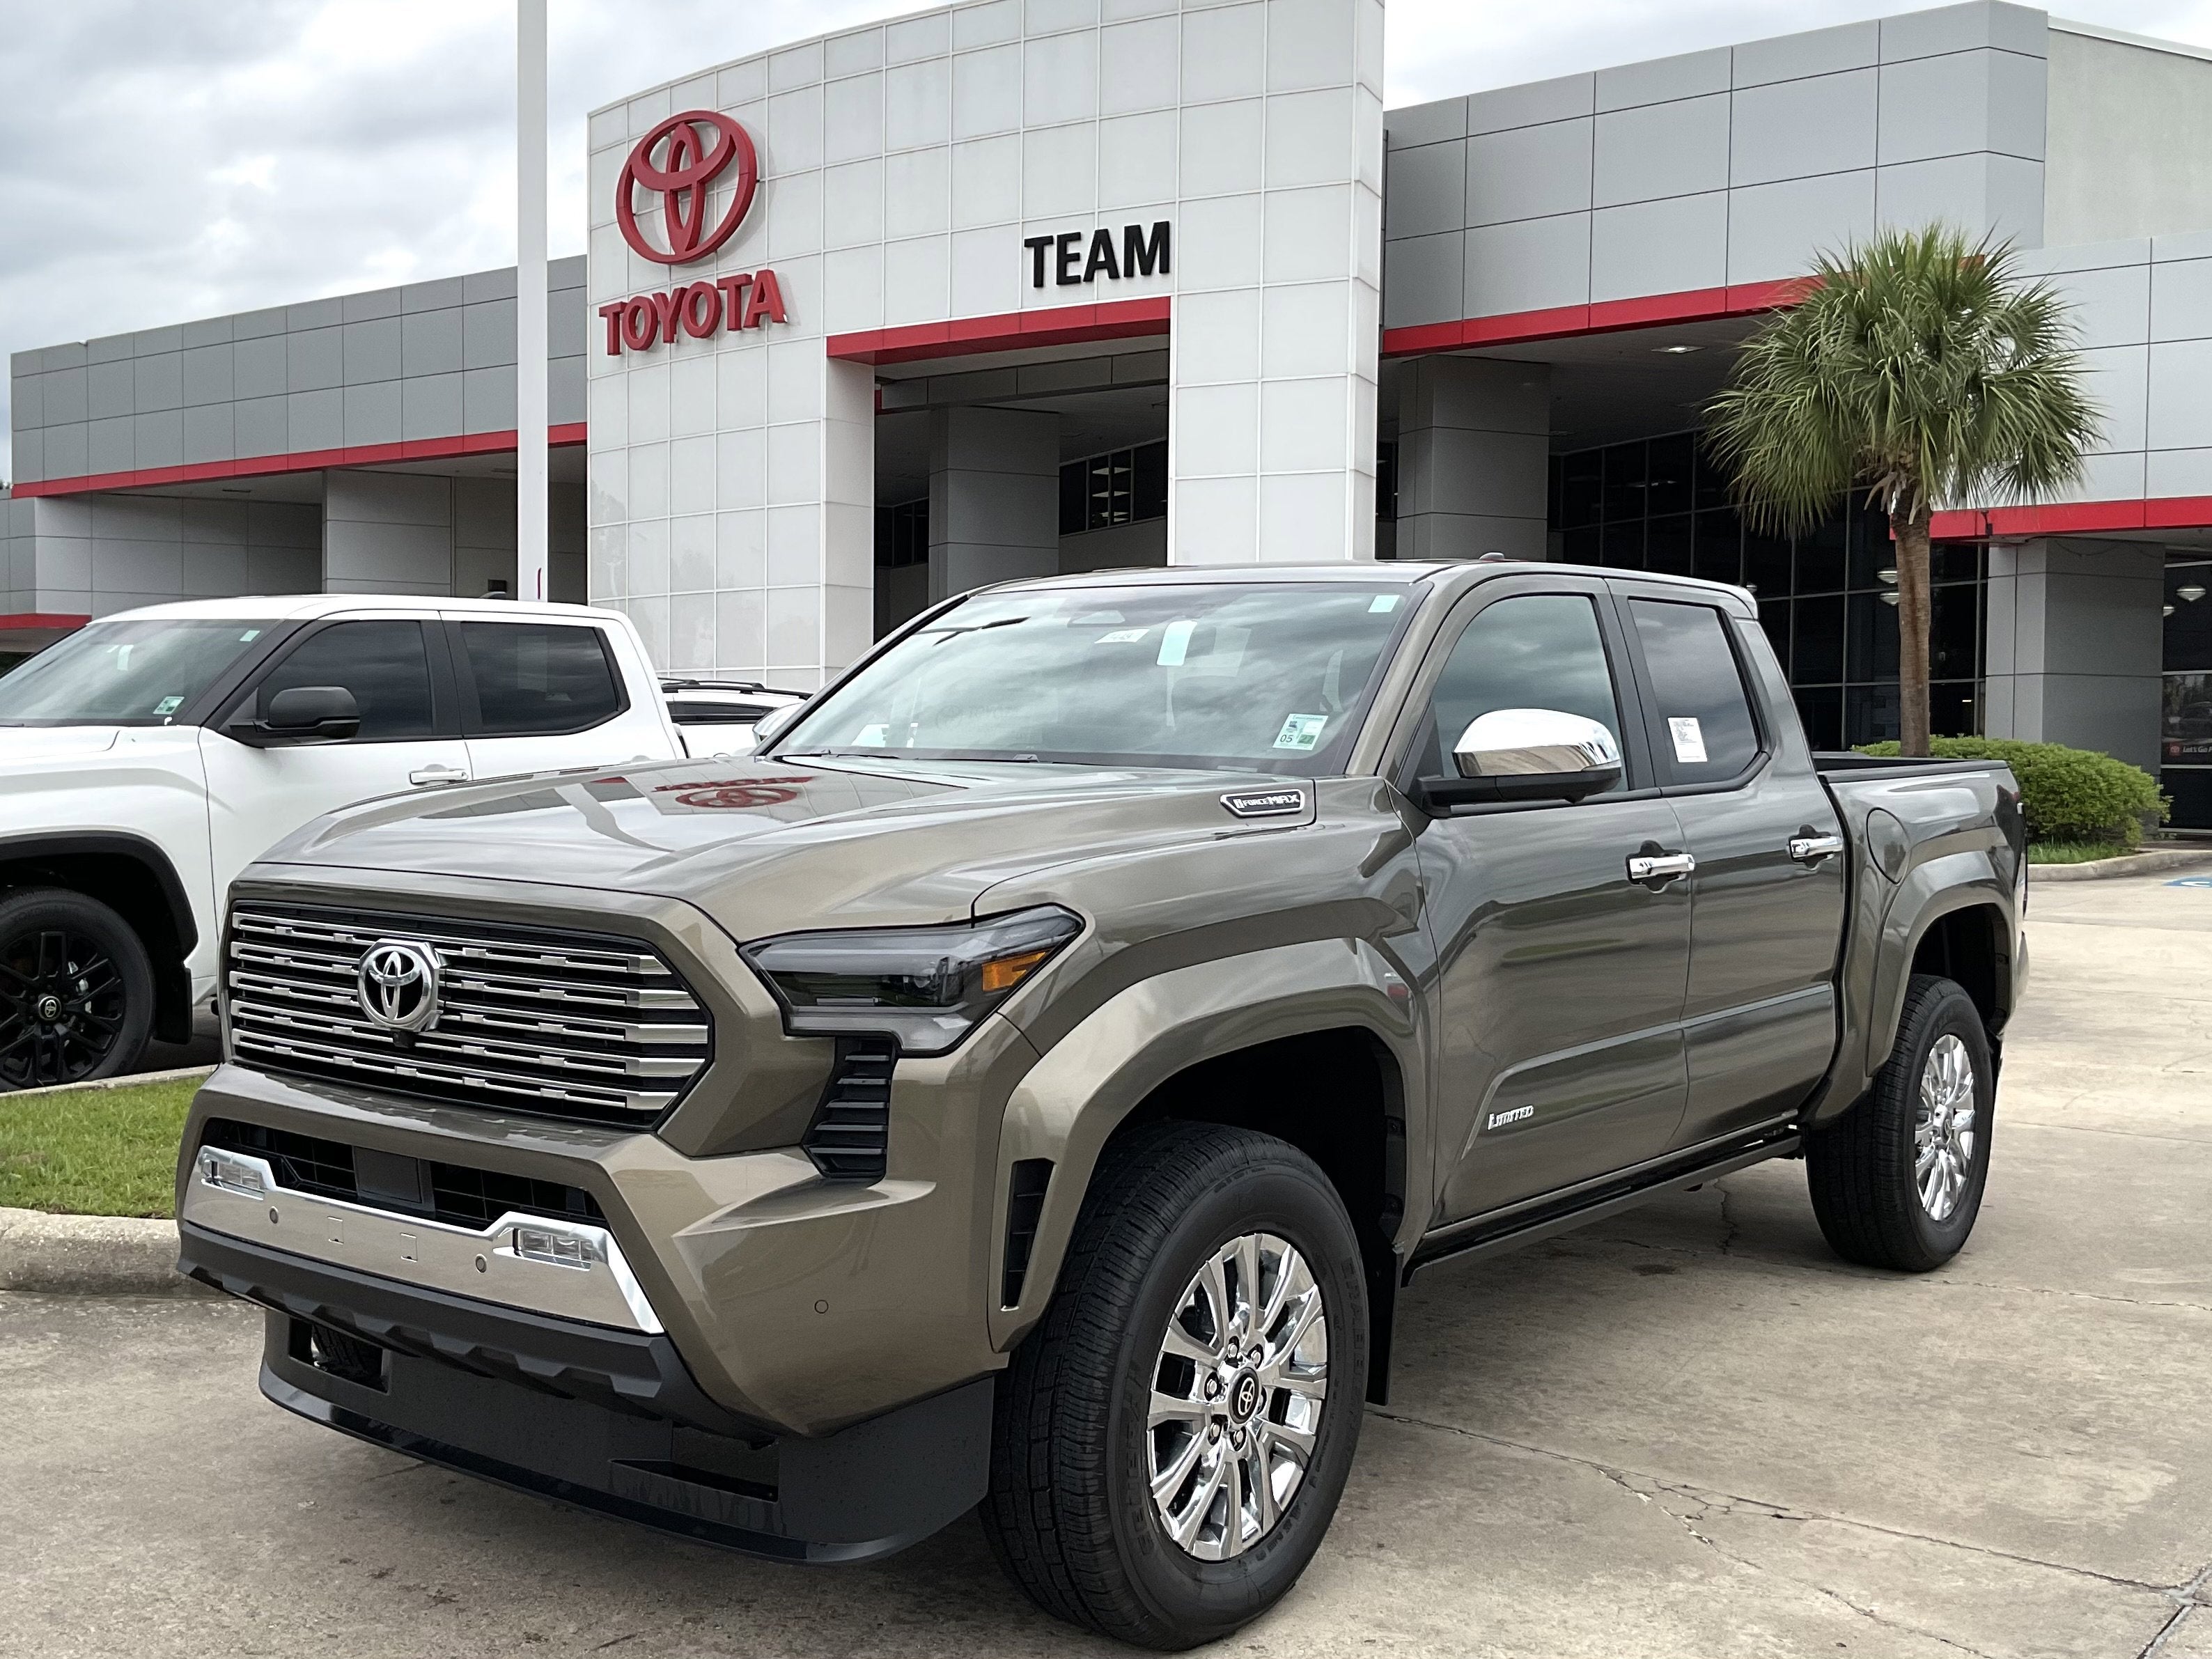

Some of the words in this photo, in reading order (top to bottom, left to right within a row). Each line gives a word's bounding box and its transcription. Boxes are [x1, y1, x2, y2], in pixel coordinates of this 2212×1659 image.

[1024, 221, 1170, 288] TEAM
[599, 270, 787, 356] TOYOTA
[1279, 734, 1293, 743] 05
